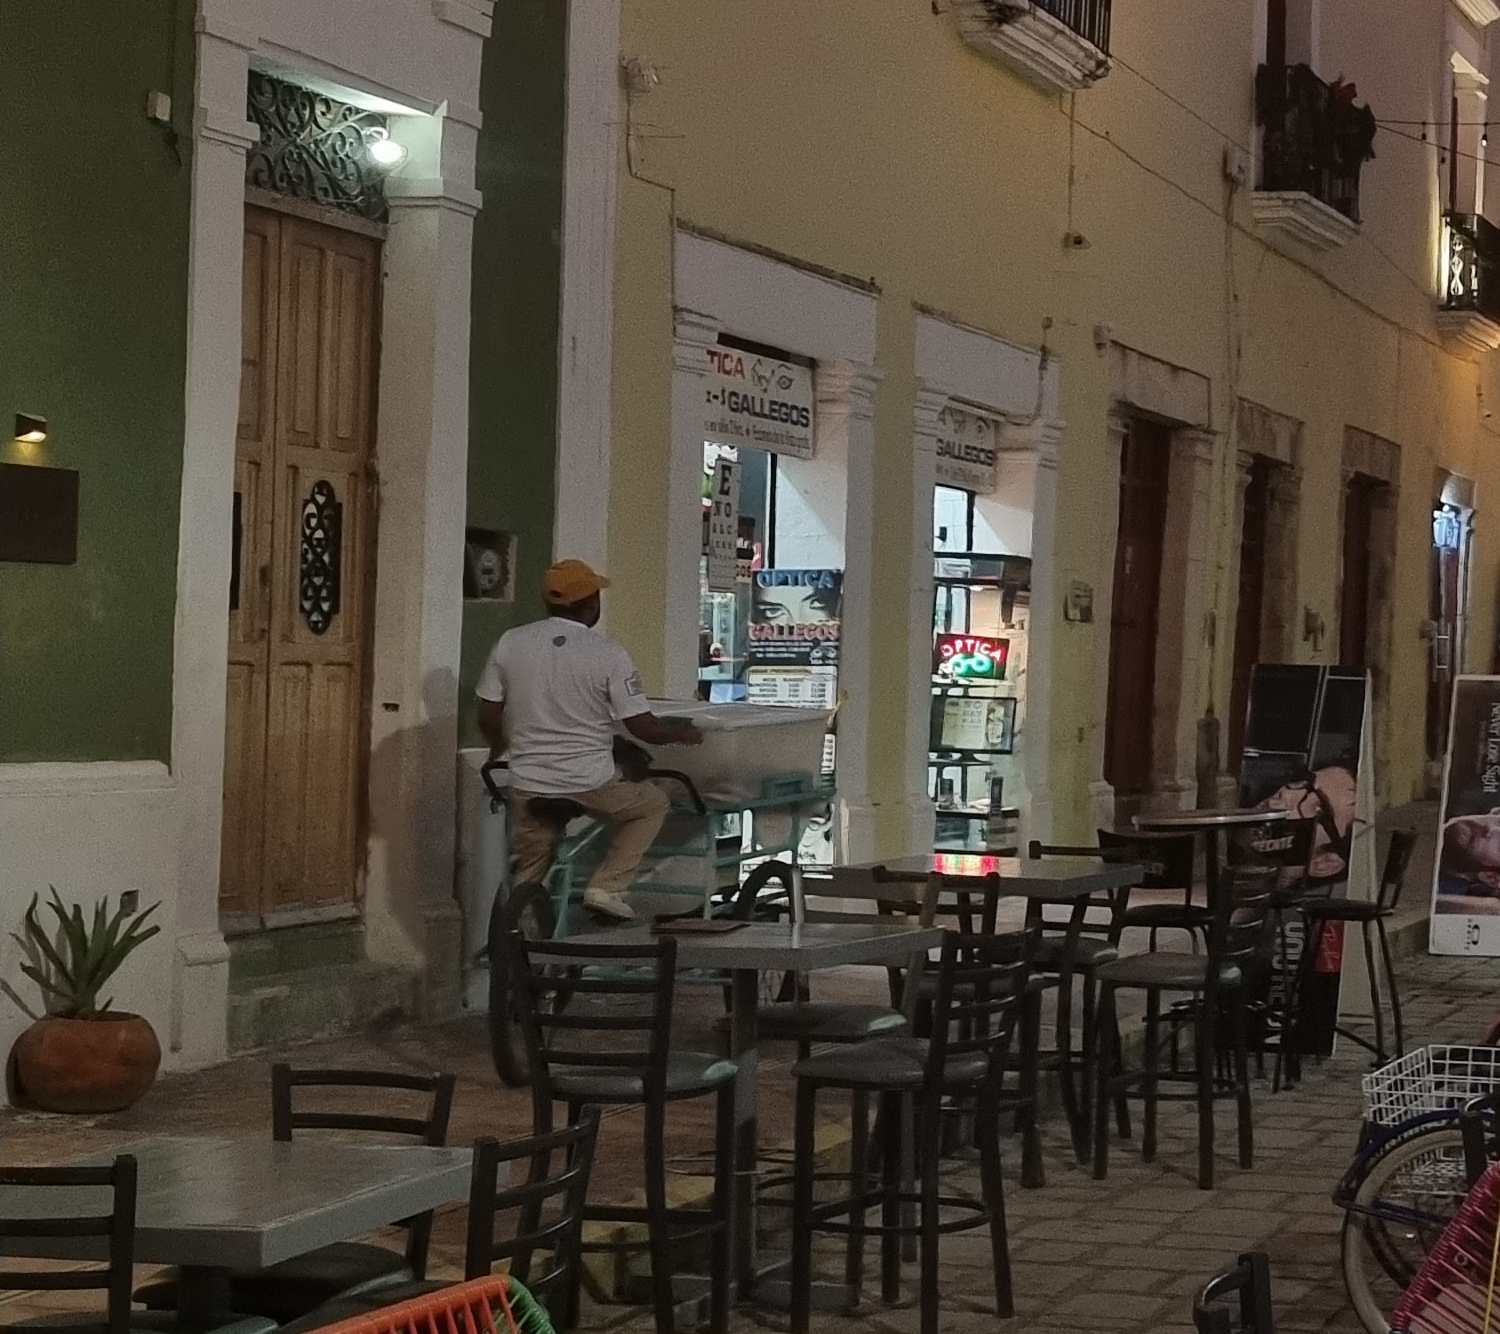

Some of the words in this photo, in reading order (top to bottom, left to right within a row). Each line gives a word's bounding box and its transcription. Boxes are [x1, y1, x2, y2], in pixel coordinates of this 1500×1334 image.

[706, 349, 745, 379] TICA
[728, 390, 810, 428] GALLEGOS
[719, 464, 732, 496] E
[757, 570, 834, 588] OPTICA
[748, 623, 839, 641] GALLEGOS
[941, 639, 1002, 662] OPTICA
[1481, 765, 1500, 793] Sight
